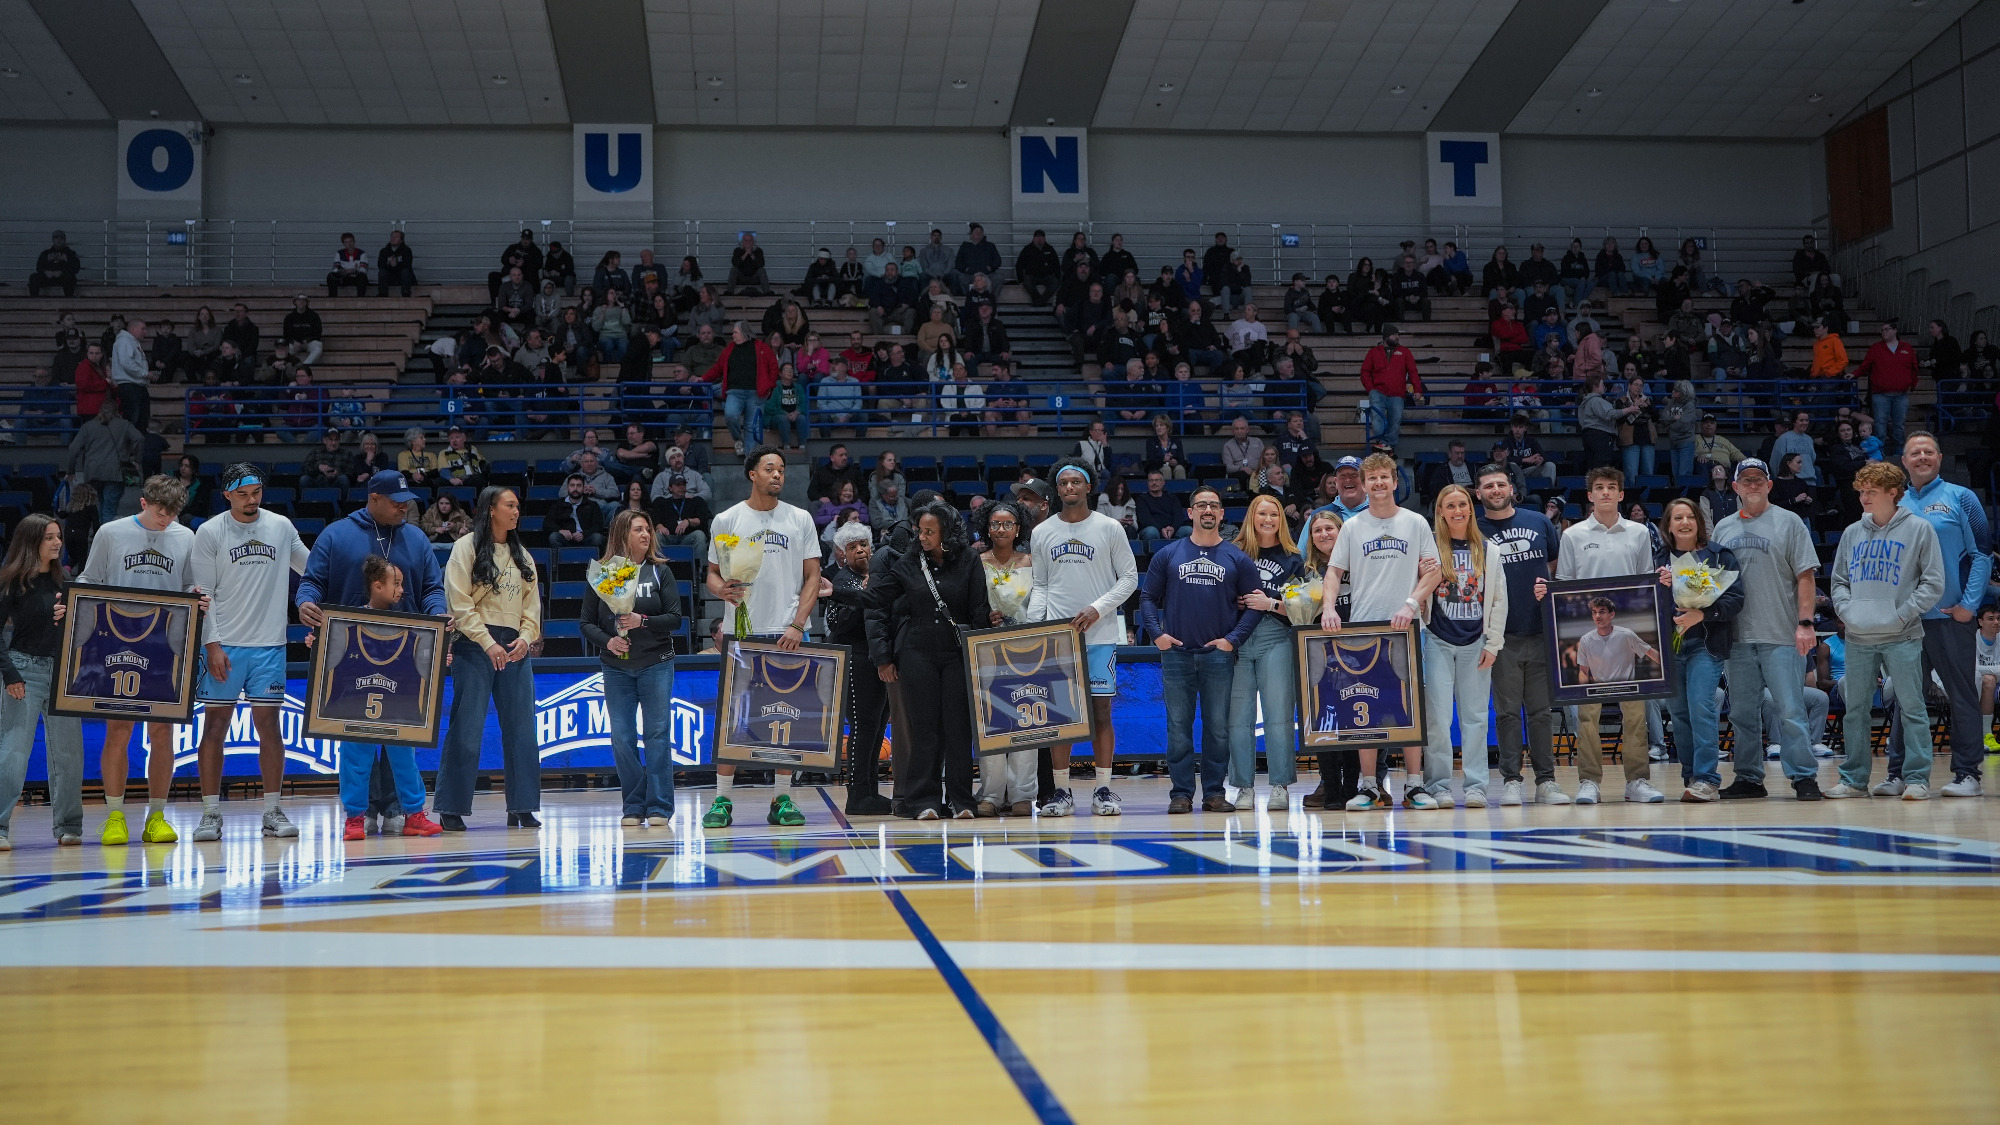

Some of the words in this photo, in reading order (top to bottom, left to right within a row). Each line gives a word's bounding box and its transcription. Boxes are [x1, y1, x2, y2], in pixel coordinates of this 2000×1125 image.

[126, 129, 194, 192] O
[585, 133, 642, 193] U
[1020, 136, 1079, 193] N
[1440, 141, 1488, 196] T
[1285, 236, 1296, 246] 22
[447, 400, 455, 413] 6
[1056, 396, 1062, 408] 8
[1502, 528, 1539, 542] MOUNT
[230, 546, 247, 563] THE
[248, 544, 276, 560] MOUNT
[1051, 545, 1066, 560] THE
[1067, 543, 1094, 560] MOUNT
[1363, 541, 1379, 556] THE
[1380, 539, 1407, 555] MOUNT
[1851, 540, 1905, 565] MOUNT
[125, 555, 143, 570] THE
[144, 552, 174, 573] MOUNT
[1500, 549, 1544, 564] SKETBALL
[1180, 563, 1196, 576] THE
[1197, 563, 1224, 578] MOUNT
[1860, 561, 1901, 586] MARY'S
[1186, 577, 1217, 586] BASKETBALL
[107, 655, 121, 666] THE
[122, 655, 148, 669] MOUNT
[110, 670, 141, 697] 10
[357, 678, 371, 689] THE
[372, 678, 397, 692] MOUNT
[1013, 689, 1025, 701] THE
[1025, 686, 1047, 697] MOUNT
[1341, 688, 1355, 700] THE
[1355, 686, 1378, 699] MOUNT
[365, 692, 384, 719] 5
[763, 705, 776, 716] THE
[777, 705, 799, 719] MOUNT
[1352, 701, 1370, 727] 3
[1016, 701, 1048, 728] 30
[769, 720, 791, 746] 11
